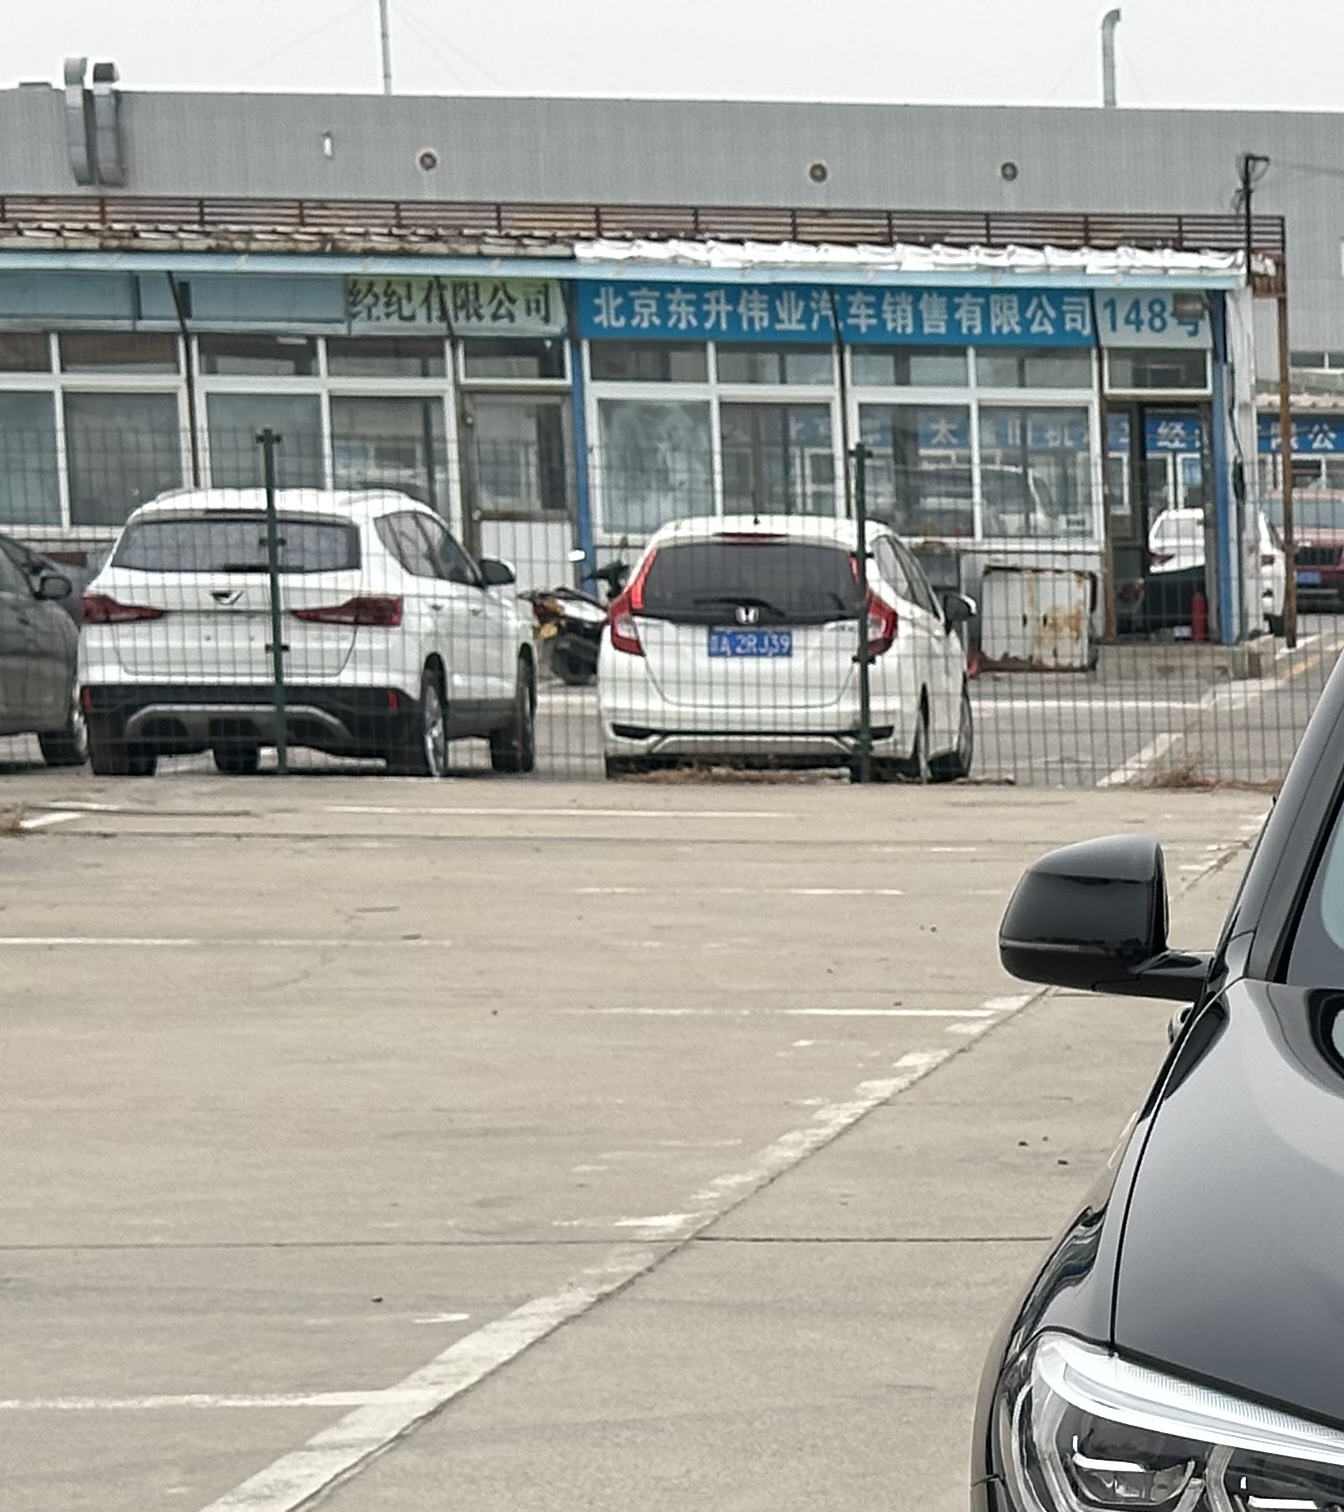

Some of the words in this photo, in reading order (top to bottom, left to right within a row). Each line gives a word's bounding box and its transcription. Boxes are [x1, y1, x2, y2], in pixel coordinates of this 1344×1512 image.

[593, 286, 1093, 337] 北京东升伟业汽车销售有限公司
